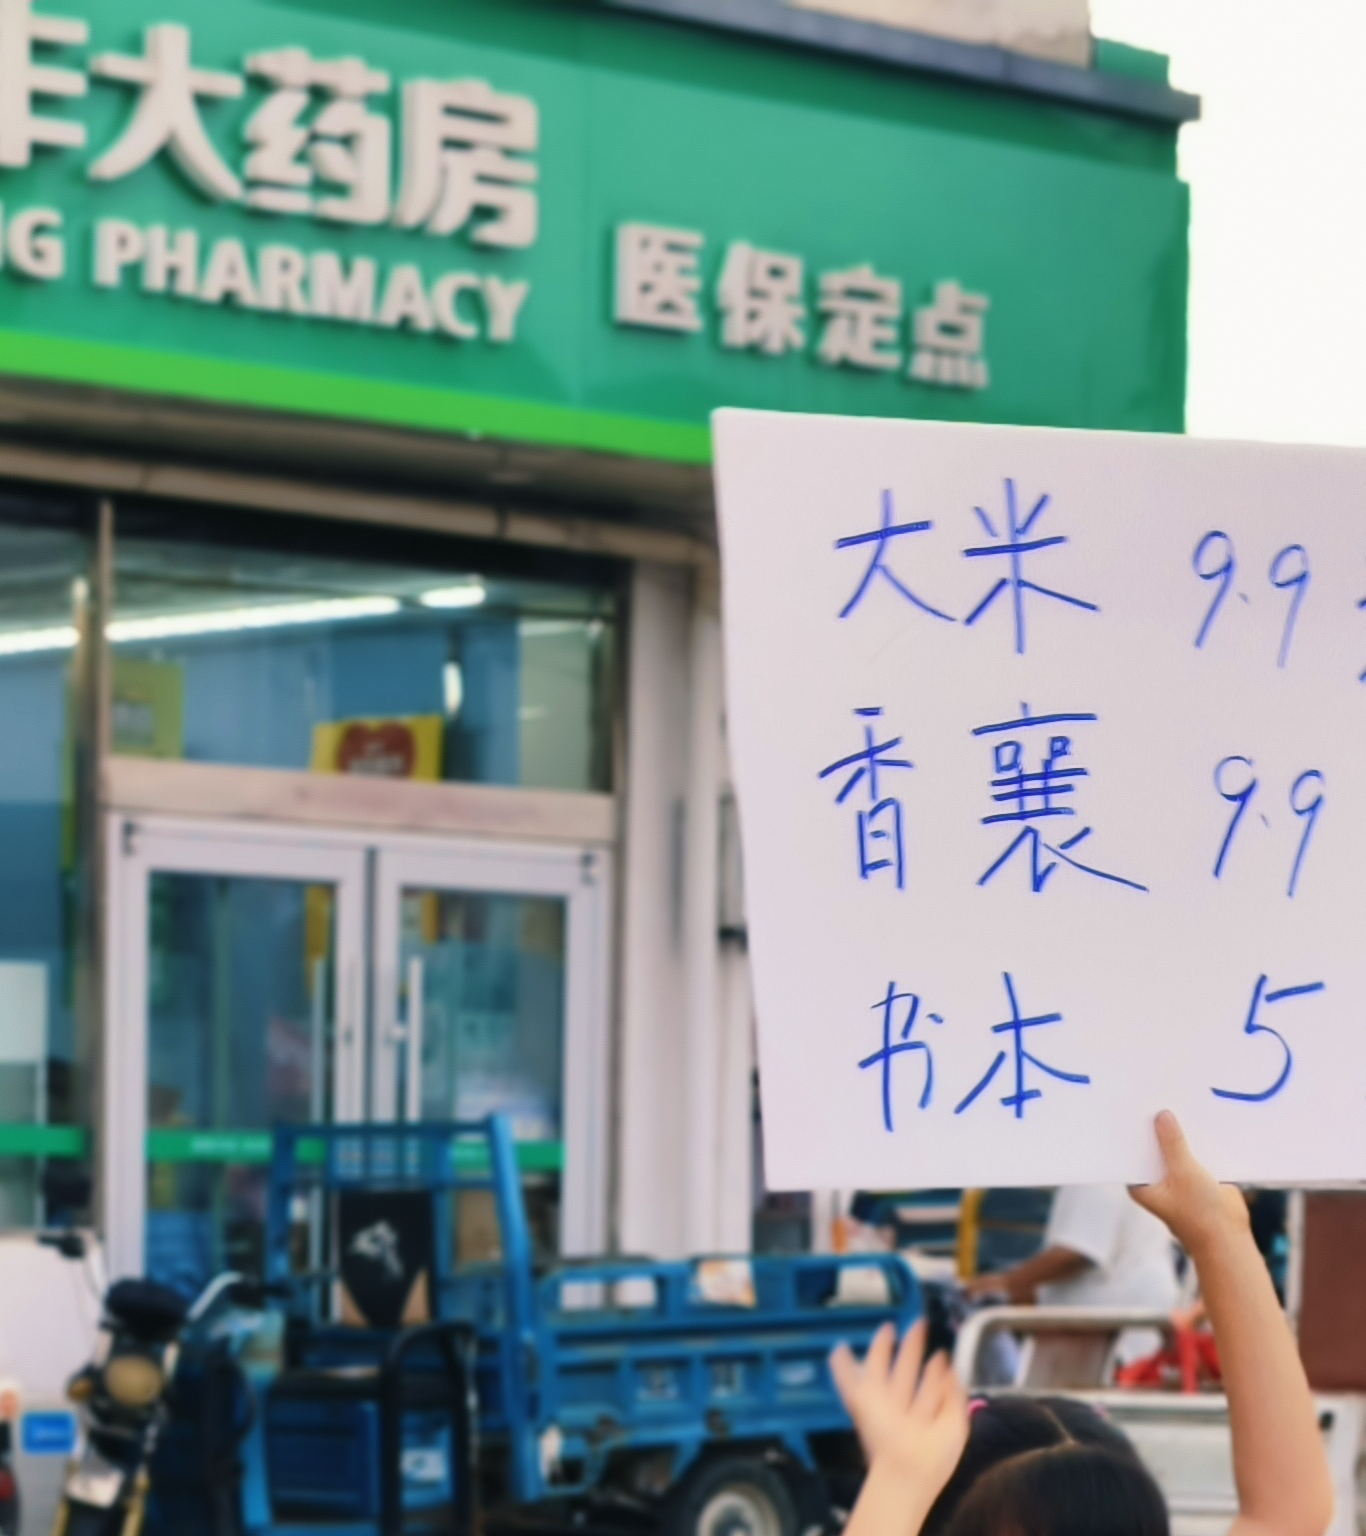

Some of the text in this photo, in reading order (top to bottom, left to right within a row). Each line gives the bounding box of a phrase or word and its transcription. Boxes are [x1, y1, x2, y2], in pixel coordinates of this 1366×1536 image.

[95, 219, 530, 342] PHARMACY
[614, 222, 990, 389] 医保定点
[834, 478, 1101, 656] 大米
[857, 972, 1092, 1134] 书本
